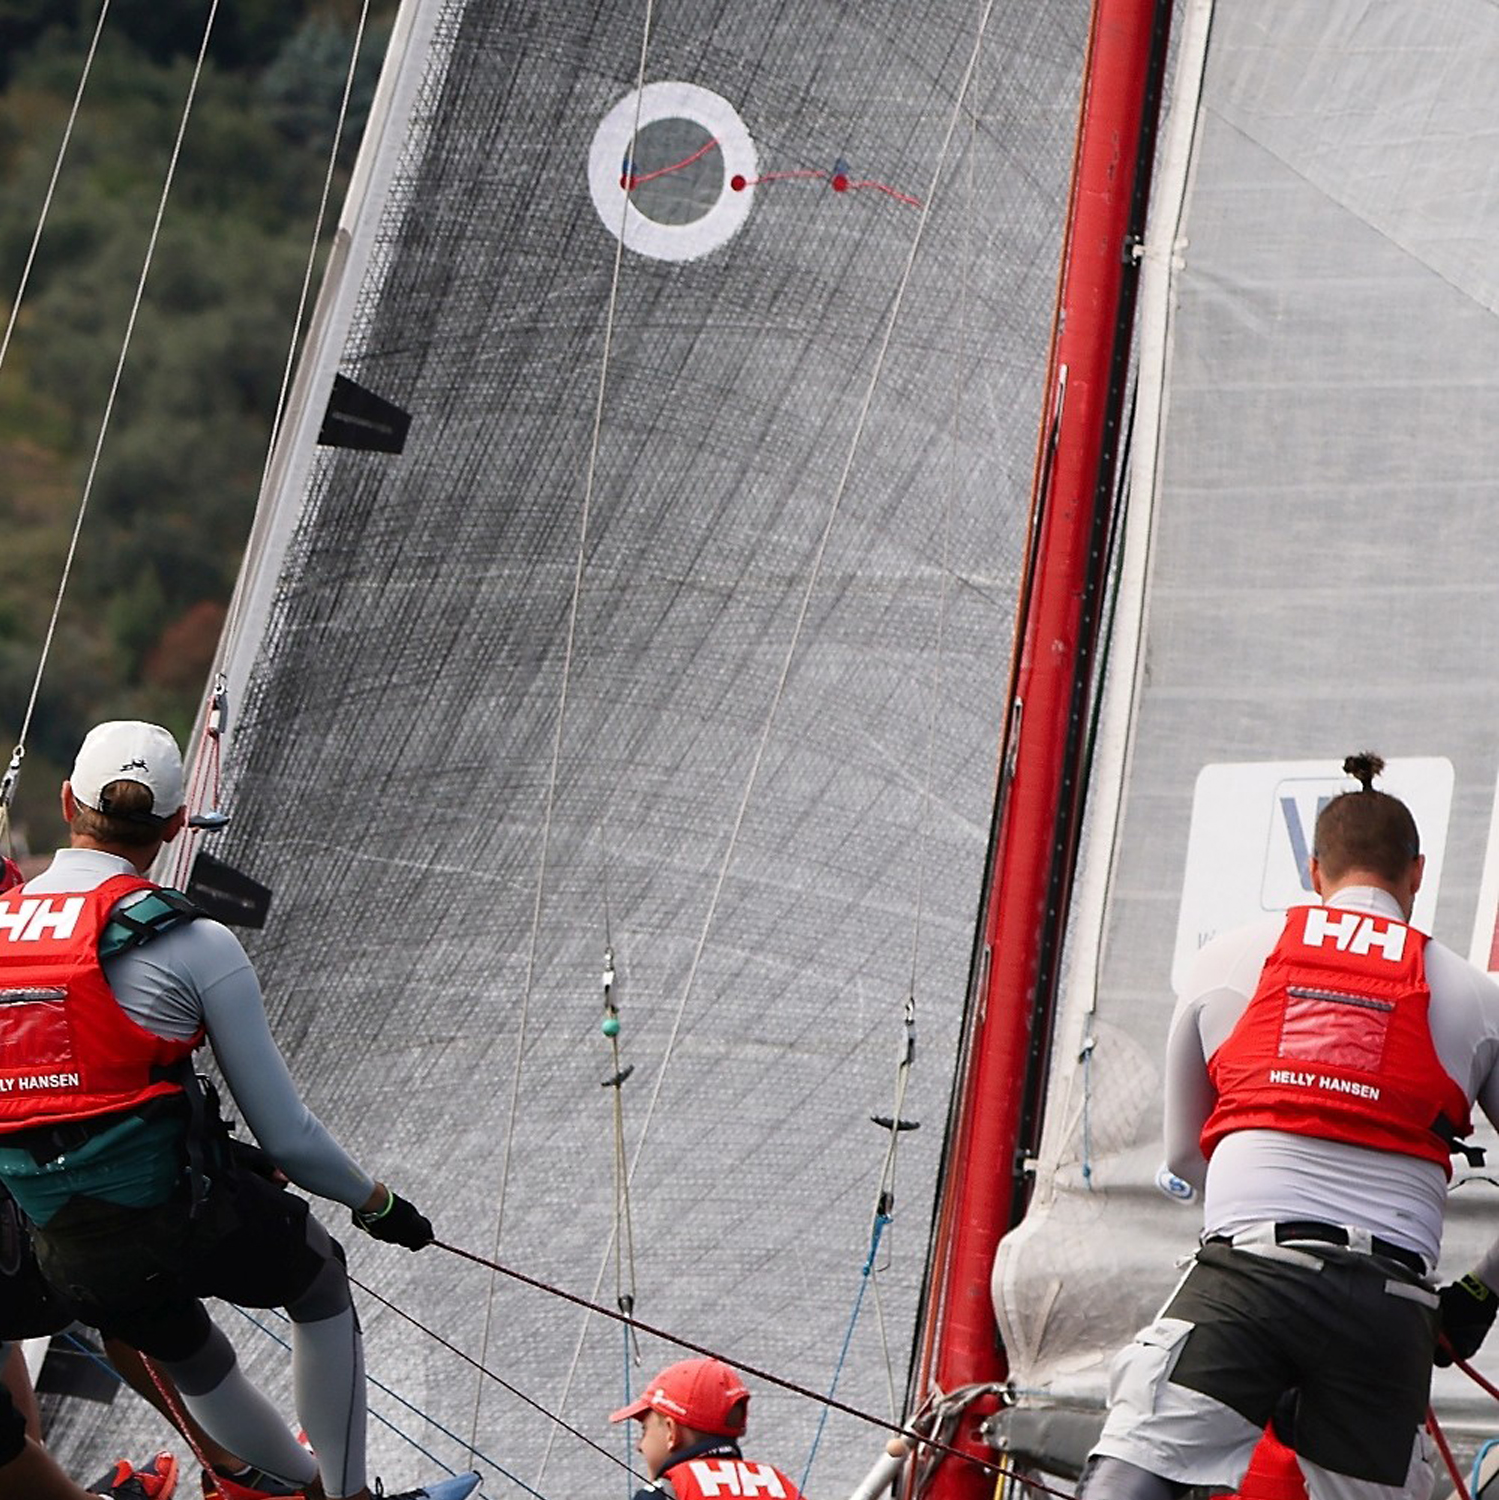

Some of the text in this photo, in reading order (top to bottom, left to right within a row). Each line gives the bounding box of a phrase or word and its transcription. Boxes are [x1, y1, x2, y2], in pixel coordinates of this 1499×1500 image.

[1303, 908, 1408, 962] HH
[18, 1073, 79, 1090] HANSEN
[1269, 1070, 1380, 1101] HELLY HANSEN
[688, 1461, 787, 1499] HH
